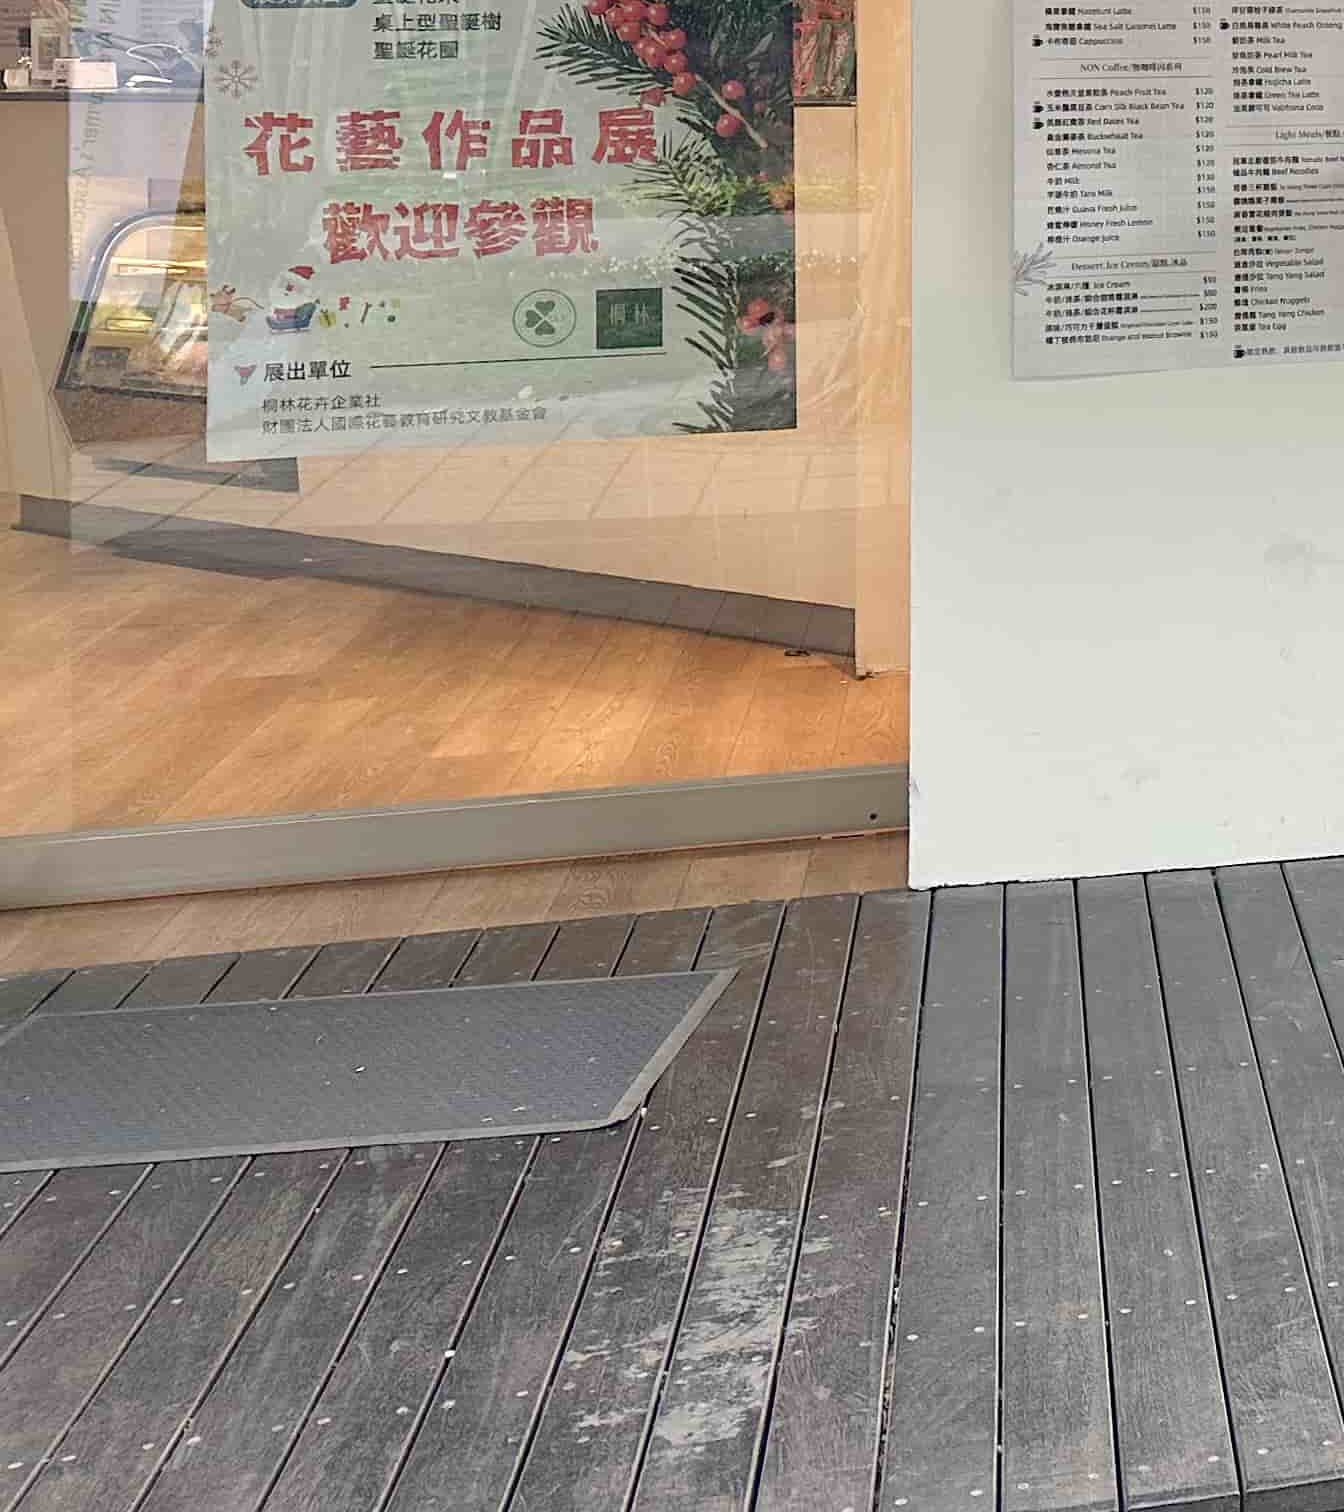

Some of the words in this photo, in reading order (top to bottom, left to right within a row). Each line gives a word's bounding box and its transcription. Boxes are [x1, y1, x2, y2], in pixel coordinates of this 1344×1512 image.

[372, 11, 502, 33] 桌上型聖誕樹
[243, 108, 659, 176] 花藝作品展
[321, 198, 599, 265] 歡迎參觀
[262, 359, 352, 383] 展出單位
